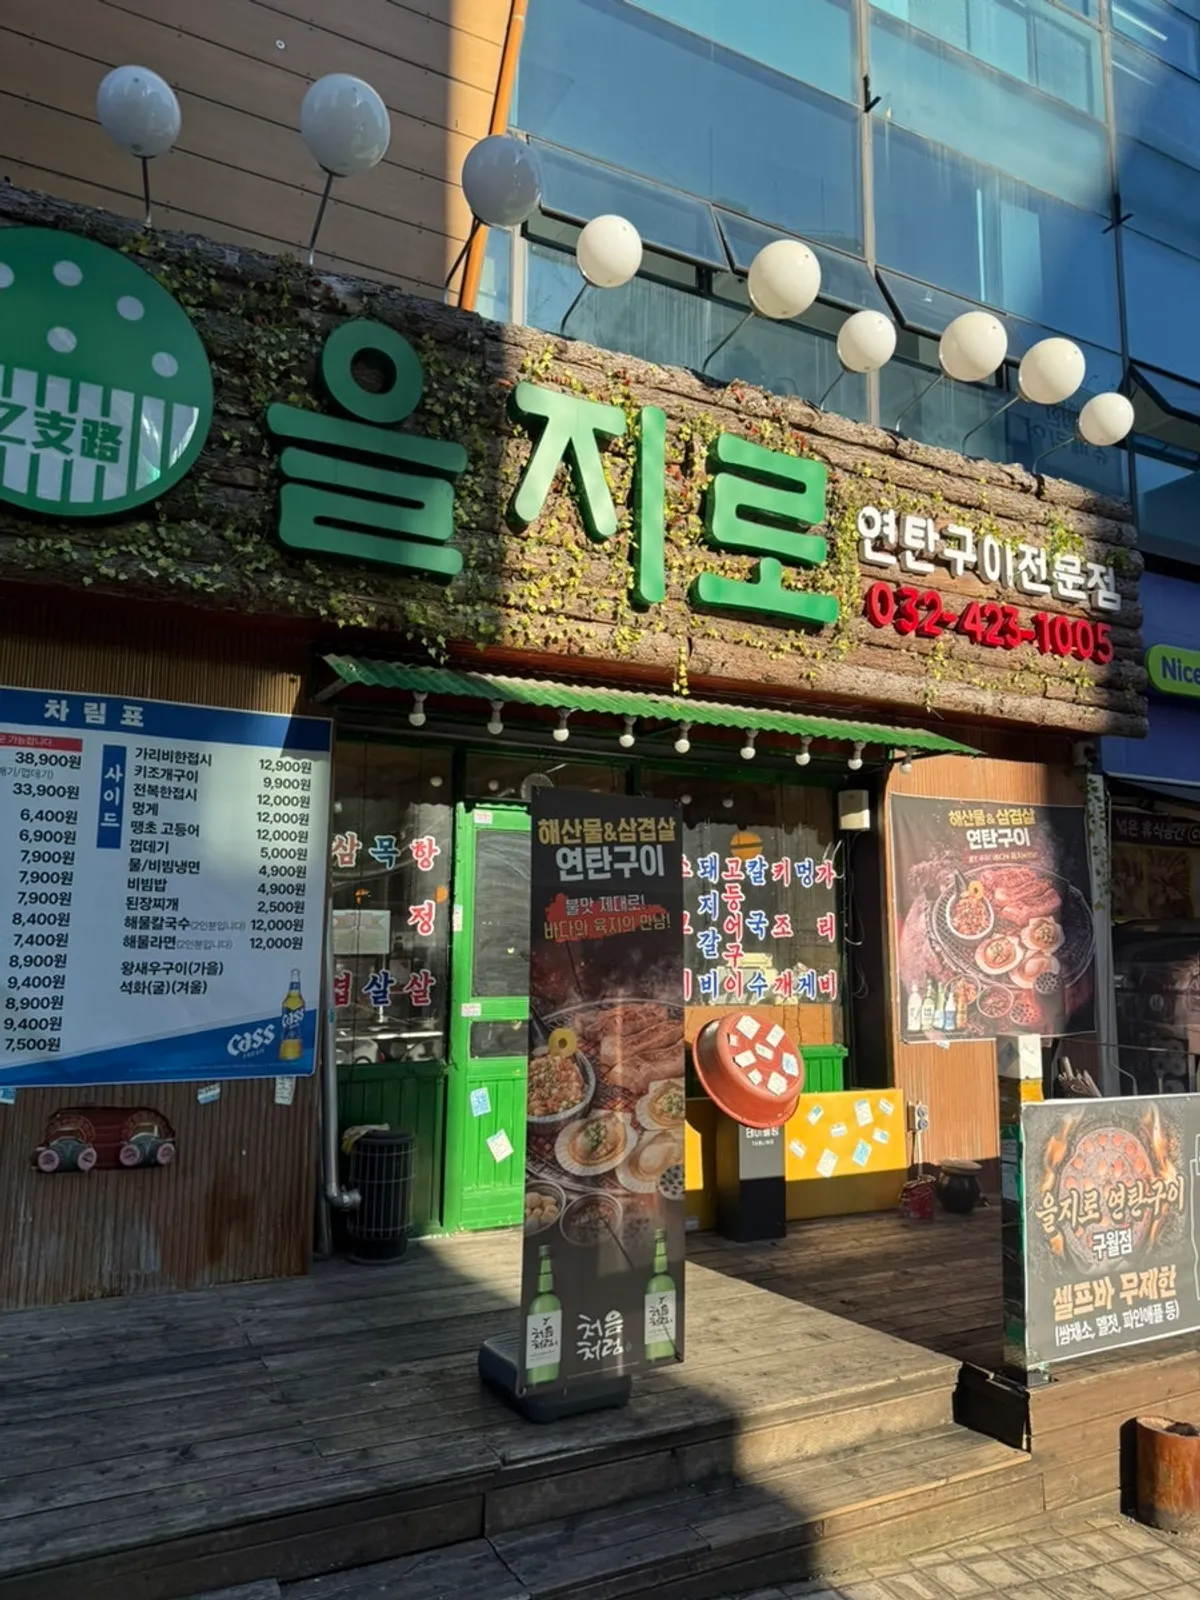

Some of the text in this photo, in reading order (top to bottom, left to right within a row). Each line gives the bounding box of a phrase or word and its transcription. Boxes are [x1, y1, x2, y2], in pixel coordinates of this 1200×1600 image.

[266, 318, 839, 624] 을지로
[856, 505, 1122, 612] 연탄구이전문점
[866, 581, 1115, 665] 032-423-1005
[44, 699, 145, 727] 차림표
[15, 751, 82, 770] 38,900원
[134, 747, 312, 774] 가리비한접시 12,900원
[133, 765, 311, 792] 키조개구이 9,900원
[12, 782, 80, 800] 33,900원
[100, 763, 124, 827] 사이드
[132, 783, 310, 809] 전복한접시 12,000원
[20, 808, 78, 825] 6,400원
[131, 801, 309, 826] 멍게 12,000원
[19, 829, 77, 845] 6,900원
[130, 820, 309, 844] 땡초 고등어 12,000원
[538, 816, 676, 845] 해산물&삼겹살
[966, 827, 1031, 850] 연탄구이
[20, 850, 75, 865] 7,900원
[129, 839, 308, 861] 껍데기 5,000원
[128, 858, 307, 879] 물/비빔냉면 4,900원
[555, 844, 665, 881] 연탄구이
[18, 871, 73, 886] 7,900원
[127, 877, 306, 897] 비빔밥 4,900원
[17, 891, 72, 906] 7,900원
[125, 896, 305, 915] 된장찌개 2,500원
[566, 894, 646, 916] 불맛 제대로!
[12, 912, 71, 927] 8,400원
[250, 919, 304, 933] 12,000원
[403, 835, 440, 1006] 항정살
[544, 913, 671, 940] 바다와 육지의 만남!
[721, 856, 745, 1000] 고등어구이
[745, 855, 768, 999] 칼국수
[770, 856, 795, 1000] 키조개
[815, 859, 838, 1000] 가리비
[13, 933, 69, 948] 7,400원
[249, 937, 304, 951] 12,000원
[9, 953, 67, 969] 8,900원
[121, 961, 224, 976] 왕새우구이(가을)
[7, 974, 65, 990] 9,400원
[5, 995, 64, 1010] 8,900원
[3, 1016, 62, 1031] 9,400원
[5, 1037, 61, 1052] 7,500원
[1035, 1174, 1185, 1234] 을지로 연탄구이
[1092, 1228, 1133, 1259] 구월점
[1053, 1264, 1177, 1322] 셀프바 무제한
[577, 1309, 624, 1339] 처음
[1121, 1303, 1165, 1330] 파인애플
[1165, 1299, 1180, 1321] 등)
[576, 1338, 624, 1361] 처럼
